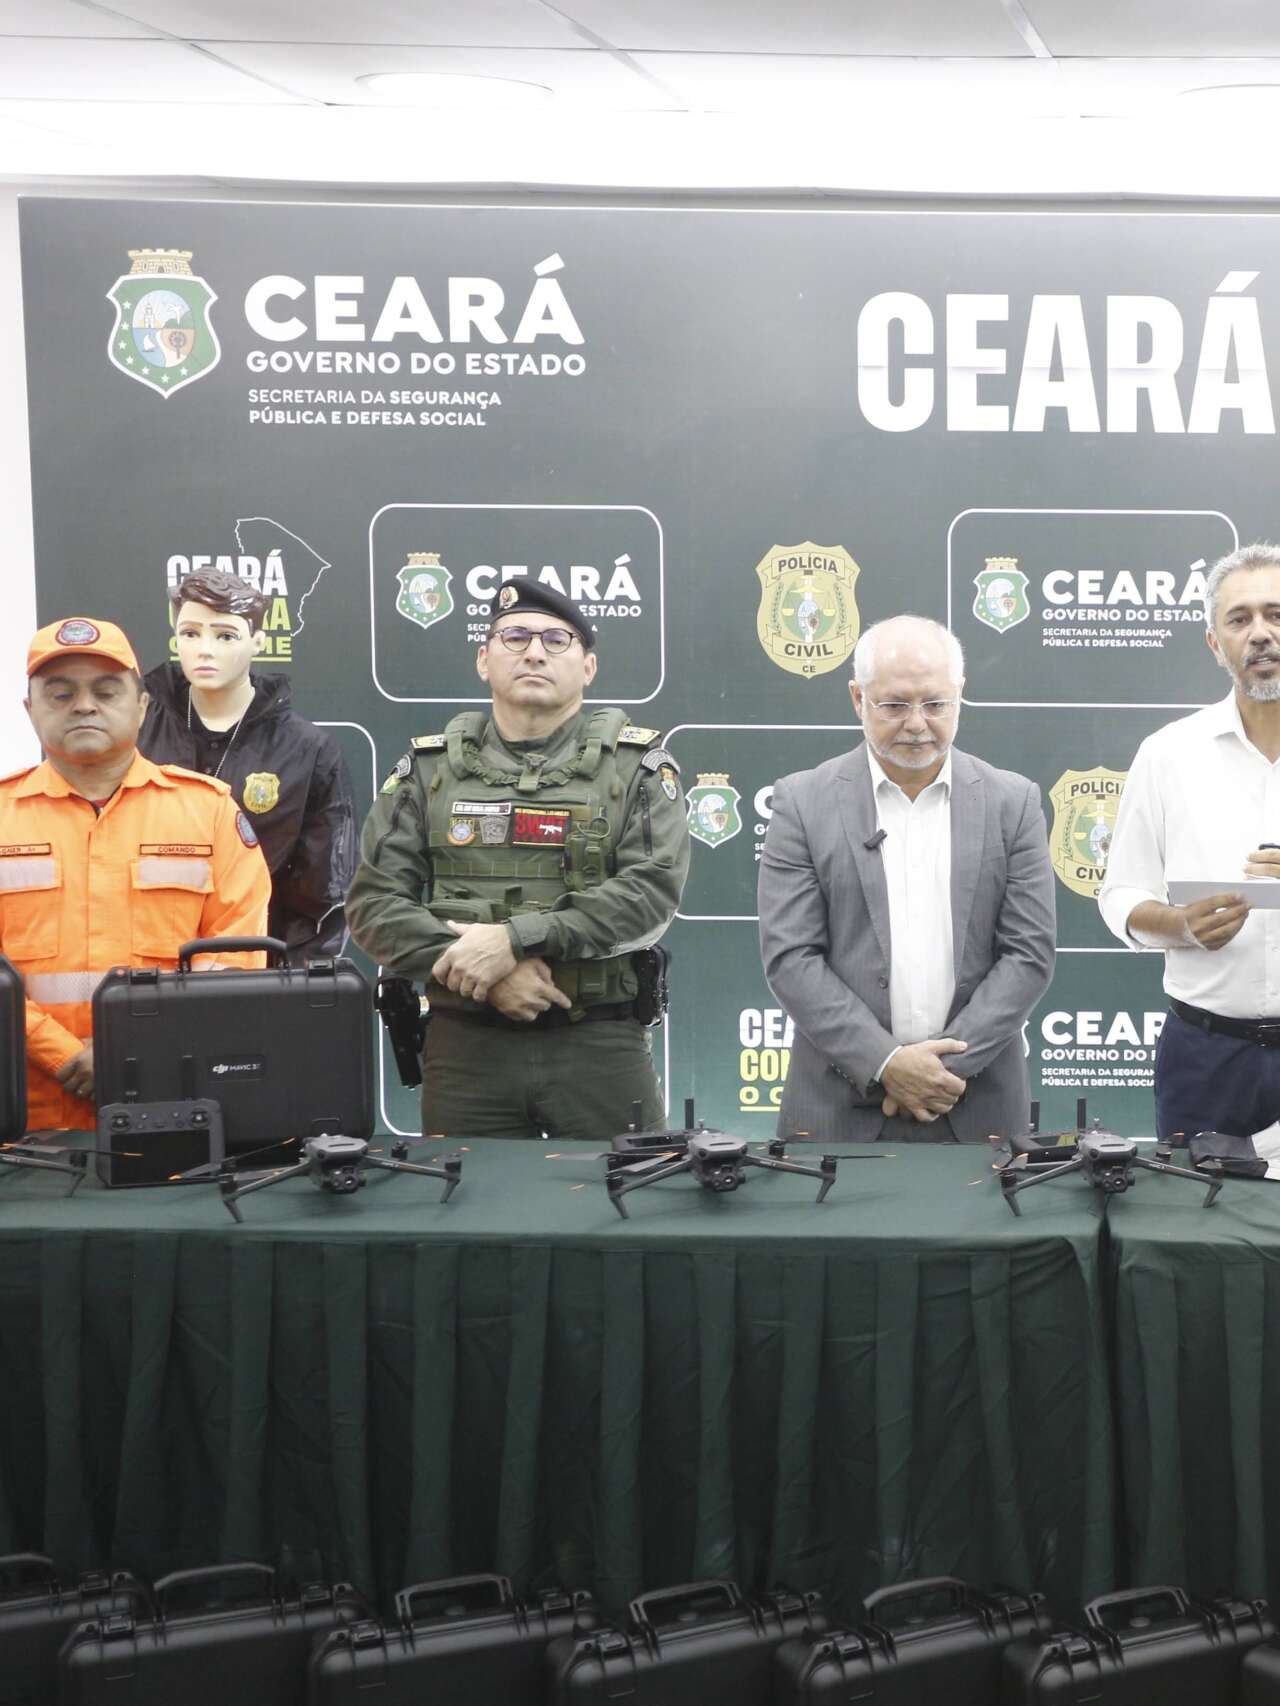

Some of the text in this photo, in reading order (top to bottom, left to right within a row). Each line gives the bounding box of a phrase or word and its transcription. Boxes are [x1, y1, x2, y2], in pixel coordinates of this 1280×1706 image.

[245, 252, 585, 345] CEARÁ
[857, 271, 1276, 434] CEARÁ
[247, 351, 586, 376] GOVERNO DO ESTADO
[248, 389, 502, 409] SECRETARIA DA SEGURANÇA
[249, 406, 486, 426] PÚBLICA E DEFESA SOCIAL
[778, 553, 838, 573] POLÍCIA
[1042, 558, 1208, 606] CEARÁ
[1042, 609, 1206, 622] GOVERNO DO ESTAD
[1042, 628, 1098, 636] SECRETARIA
[1114, 629, 1172, 639] SEGURANÇA
[1042, 637, 1164, 648] PÚBLICA E DEFESA SOCIAL
[784, 643, 833, 657] CIVIL
[802, 665, 816, 673] CE
[1041, 1011, 1167, 1045] CEAR
[1041, 1049, 1147, 1061] GOVERNO DO
[1042, 1068, 1096, 1076] SECRETARIA
[1098, 1068, 1111, 1076] DA
[1042, 1077, 1081, 1087] PÚBLICA
[1090, 1079, 1126, 1087] DEFESA
[739, 1086, 759, 1104] O
